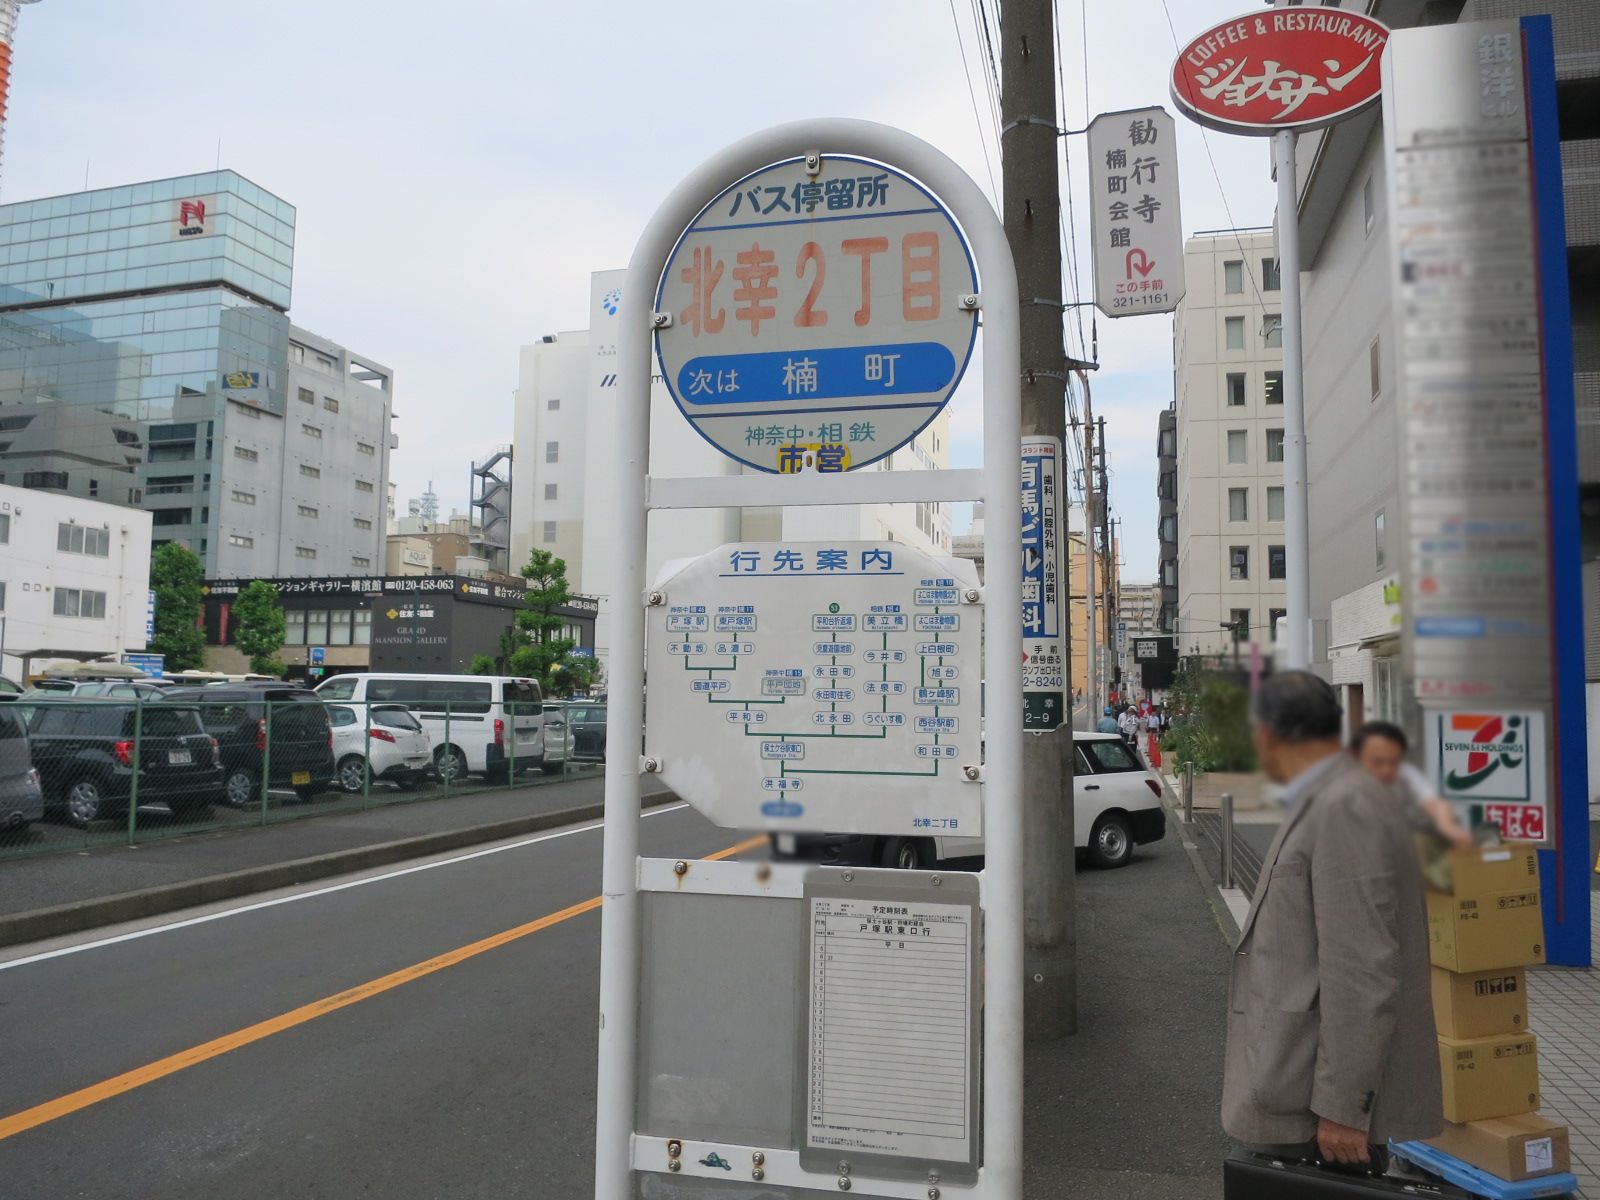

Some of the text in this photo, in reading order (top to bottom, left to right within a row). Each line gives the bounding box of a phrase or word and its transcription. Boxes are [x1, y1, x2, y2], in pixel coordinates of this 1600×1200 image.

[1187, 13, 1386, 67] COFFEE & RESTAURANT
[1477, 33, 1518, 118] 銀洋ビル
[1194, 52, 1374, 120] ジョナサン
[1128, 118, 1161, 223] 勧行寺
[729, 174, 889, 217] バス停留所
[1106, 149, 1131, 248] 楠町会館
[680, 231, 942, 337] 北幸2丁目
[1115, 279, 1163, 294] この手前
[1113, 293, 1169, 308] 321-1161
[688, 354, 901, 395] 次は 楠町
[409, 551, 427, 561] AQUA
[730, 548, 892, 572] 行先案内
[395, 580, 454, 591] 0120-458-063
[919, 644, 955, 654] 上白根町
[1034, 645, 1058, 654] 手前
[867, 652, 903, 661] 今井町
[1031, 655, 1061, 664] 信号曲る
[816, 667, 851, 676] 永田町
[932, 668, 954, 677] 旭台
[694, 682, 726, 690] 国道平戸
[867, 684, 903, 693] 法泉町
[816, 690, 851, 699] 永田町住宅
[729, 713, 764, 722] 平和台
[816, 714, 851, 723] 北永田
[867, 715, 903, 724] うぐいす橋
[919, 718, 955, 727] 西谷駅前
[1025, 713, 1050, 723] 2-9
[918, 747, 954, 756] 和田町
[913, 819, 958, 828] 北幸二丁目
[872, 906, 908, 915] 予定時刻表
[860, 924, 930, 936] 戸塚駅東口行
